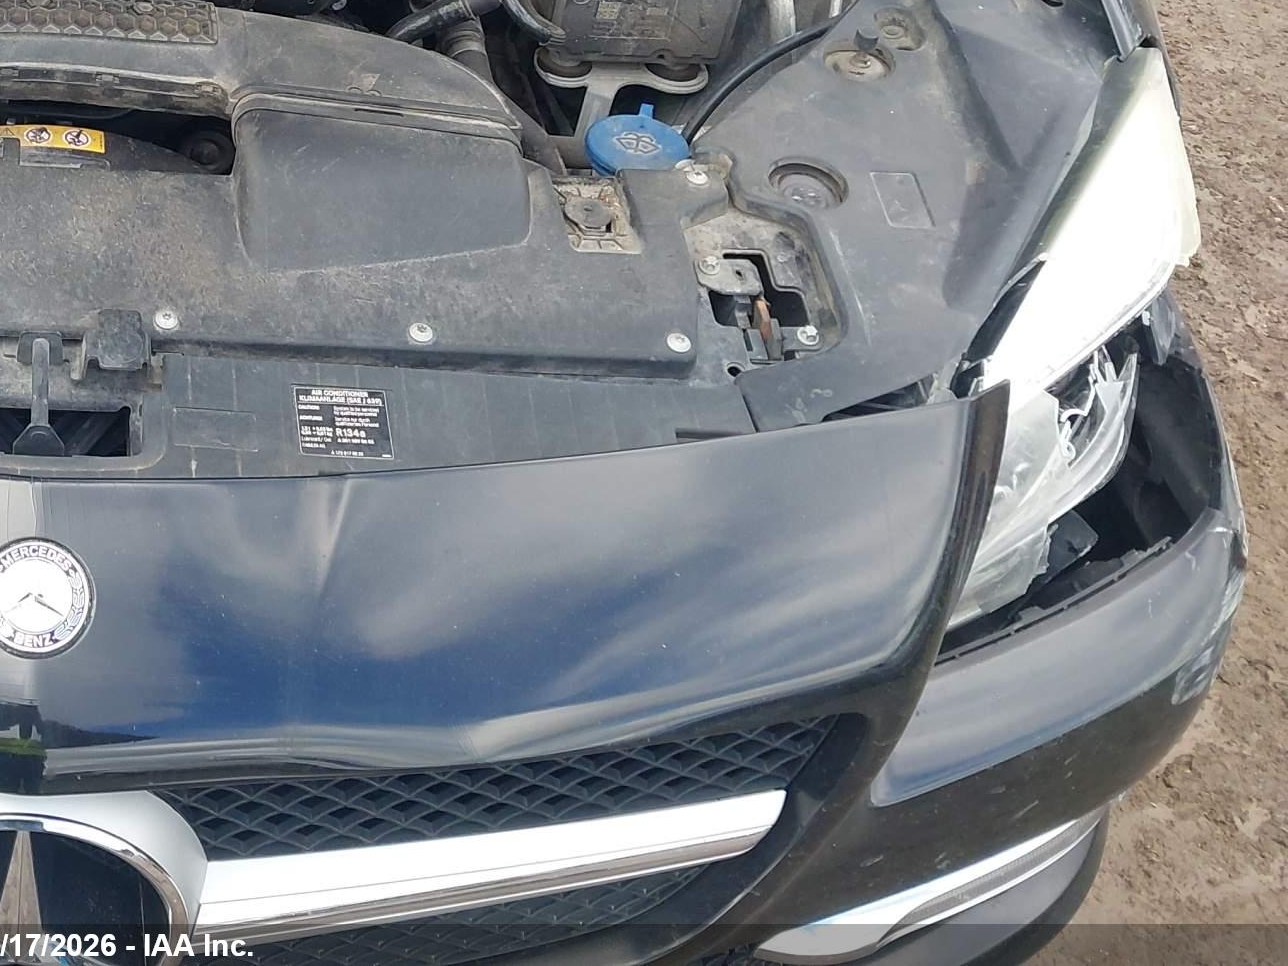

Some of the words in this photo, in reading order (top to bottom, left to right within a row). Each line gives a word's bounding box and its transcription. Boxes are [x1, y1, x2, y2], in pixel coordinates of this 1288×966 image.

[336, 428, 366, 438] R134a
[0, 545, 72, 571] MERCEDES
[14, 632, 54, 648] BENZ
